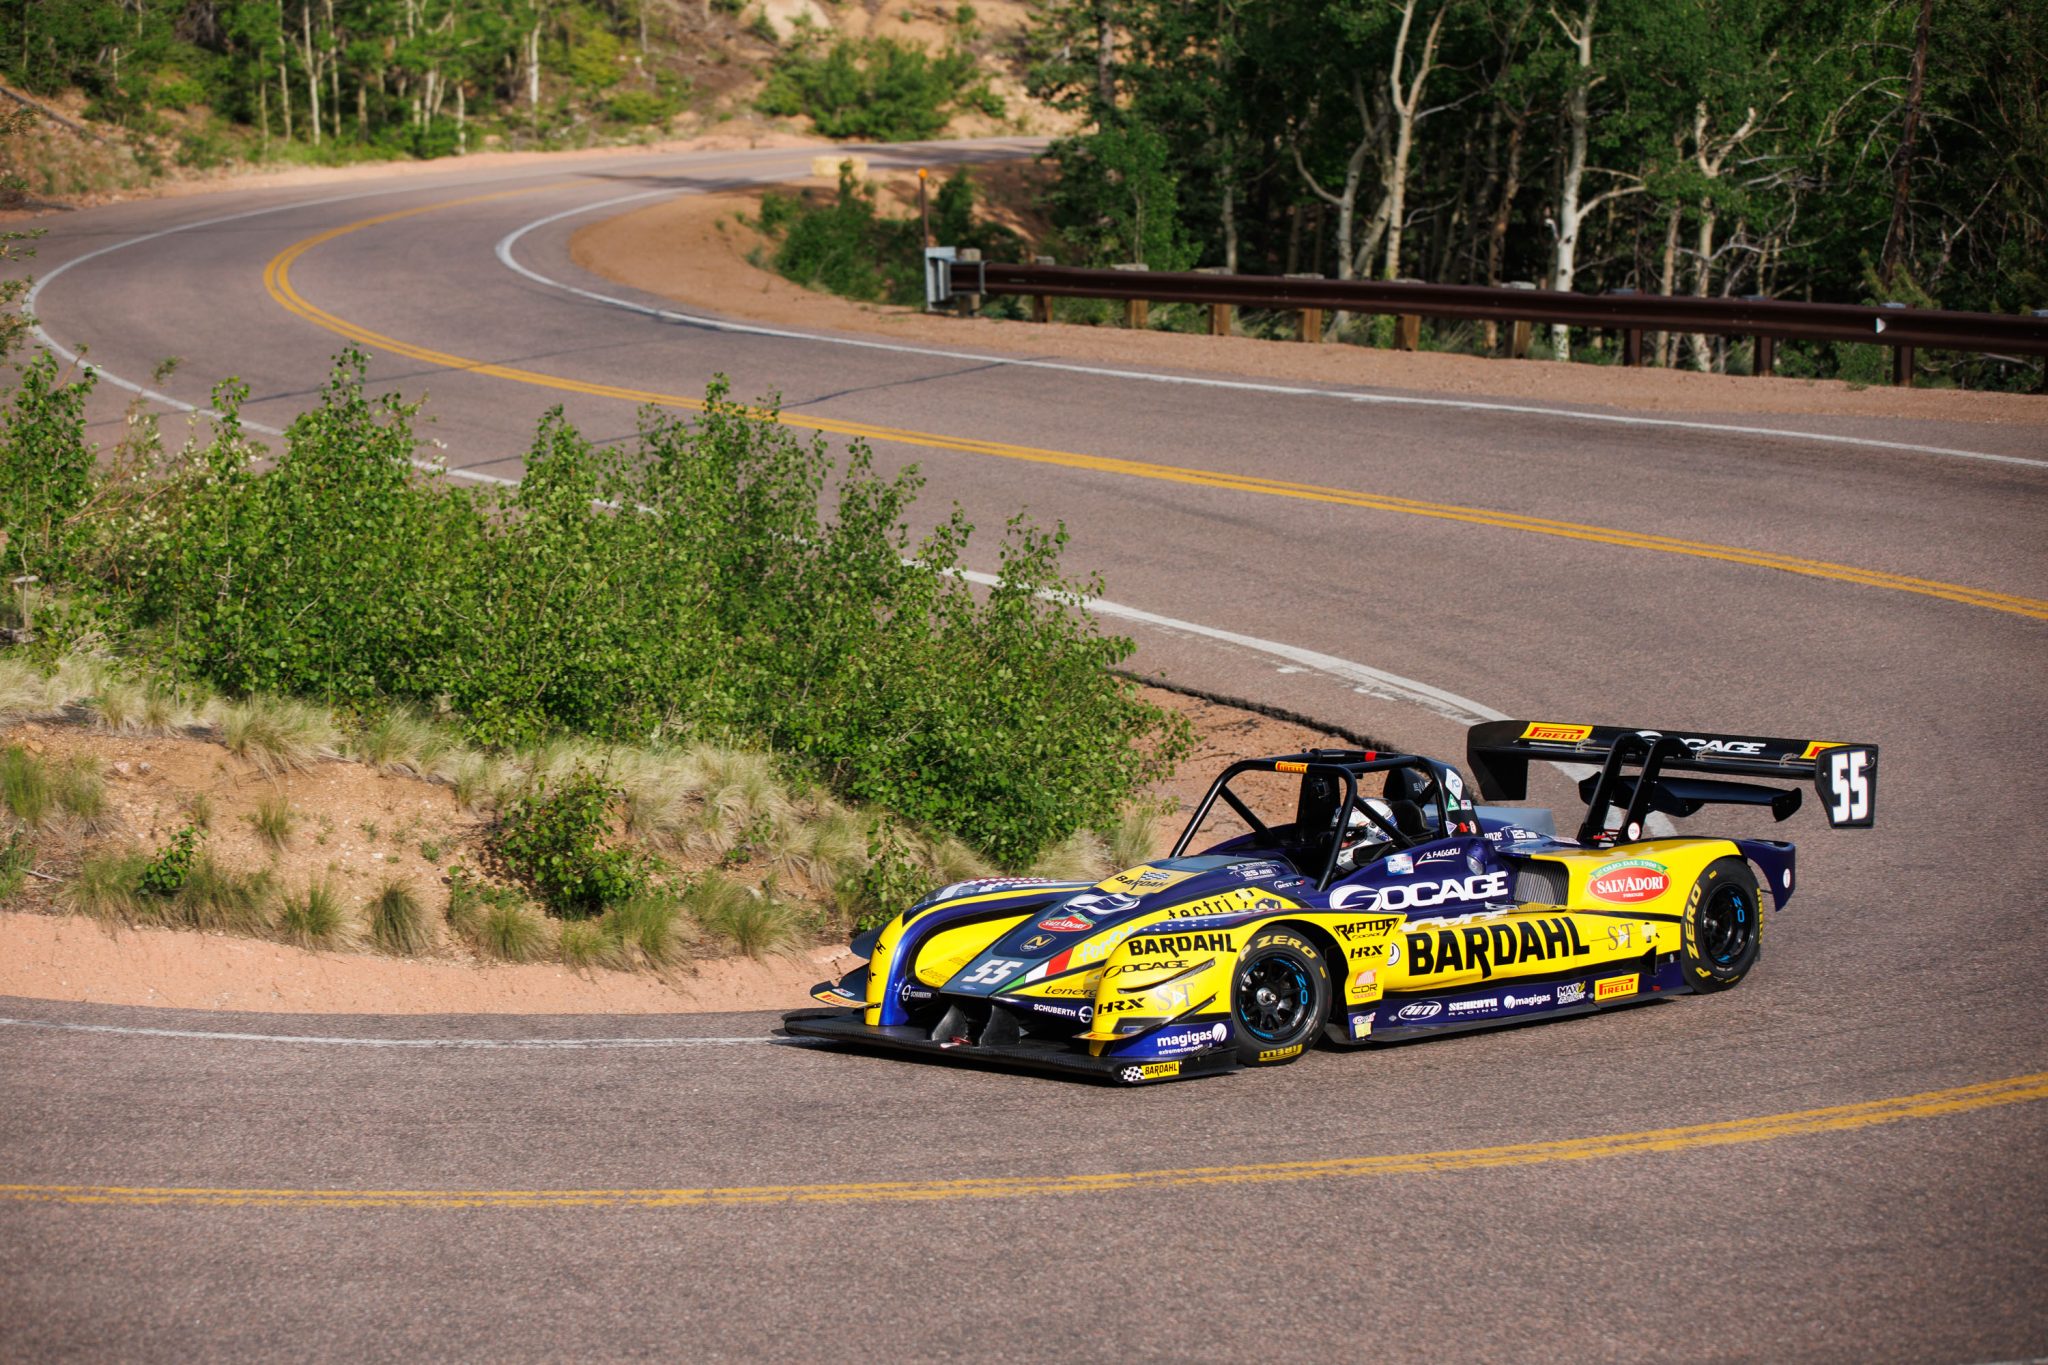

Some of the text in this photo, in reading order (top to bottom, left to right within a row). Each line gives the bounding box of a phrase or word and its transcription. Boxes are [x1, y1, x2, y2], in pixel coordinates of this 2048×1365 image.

[1529, 726, 1585, 741] PIRELLI
[1831, 750, 1868, 824] 55
[1596, 876, 1663, 894] SALVADORI
[1333, 917, 1400, 941] RAPTOR
[1685, 883, 1702, 959] ZERO
[1128, 932, 1237, 958] BARDAHL
[1256, 935, 1318, 960] ZERO
[1350, 944, 1384, 959] HRX
[1405, 916, 1590, 979] BARDAHL
[961, 959, 1024, 985] 55
[1351, 983, 1378, 994] CDR
[1599, 978, 1634, 996] PIRELLI
[1098, 997, 1146, 1015] HRX
[1516, 993, 1551, 1006] magigas
[1033, 1003, 1077, 1017] SCHUBERTH
[1448, 1007, 1499, 1016] RACING
[1156, 1029, 1213, 1048] magigas
[1145, 1061, 1179, 1077] BARDAHL
